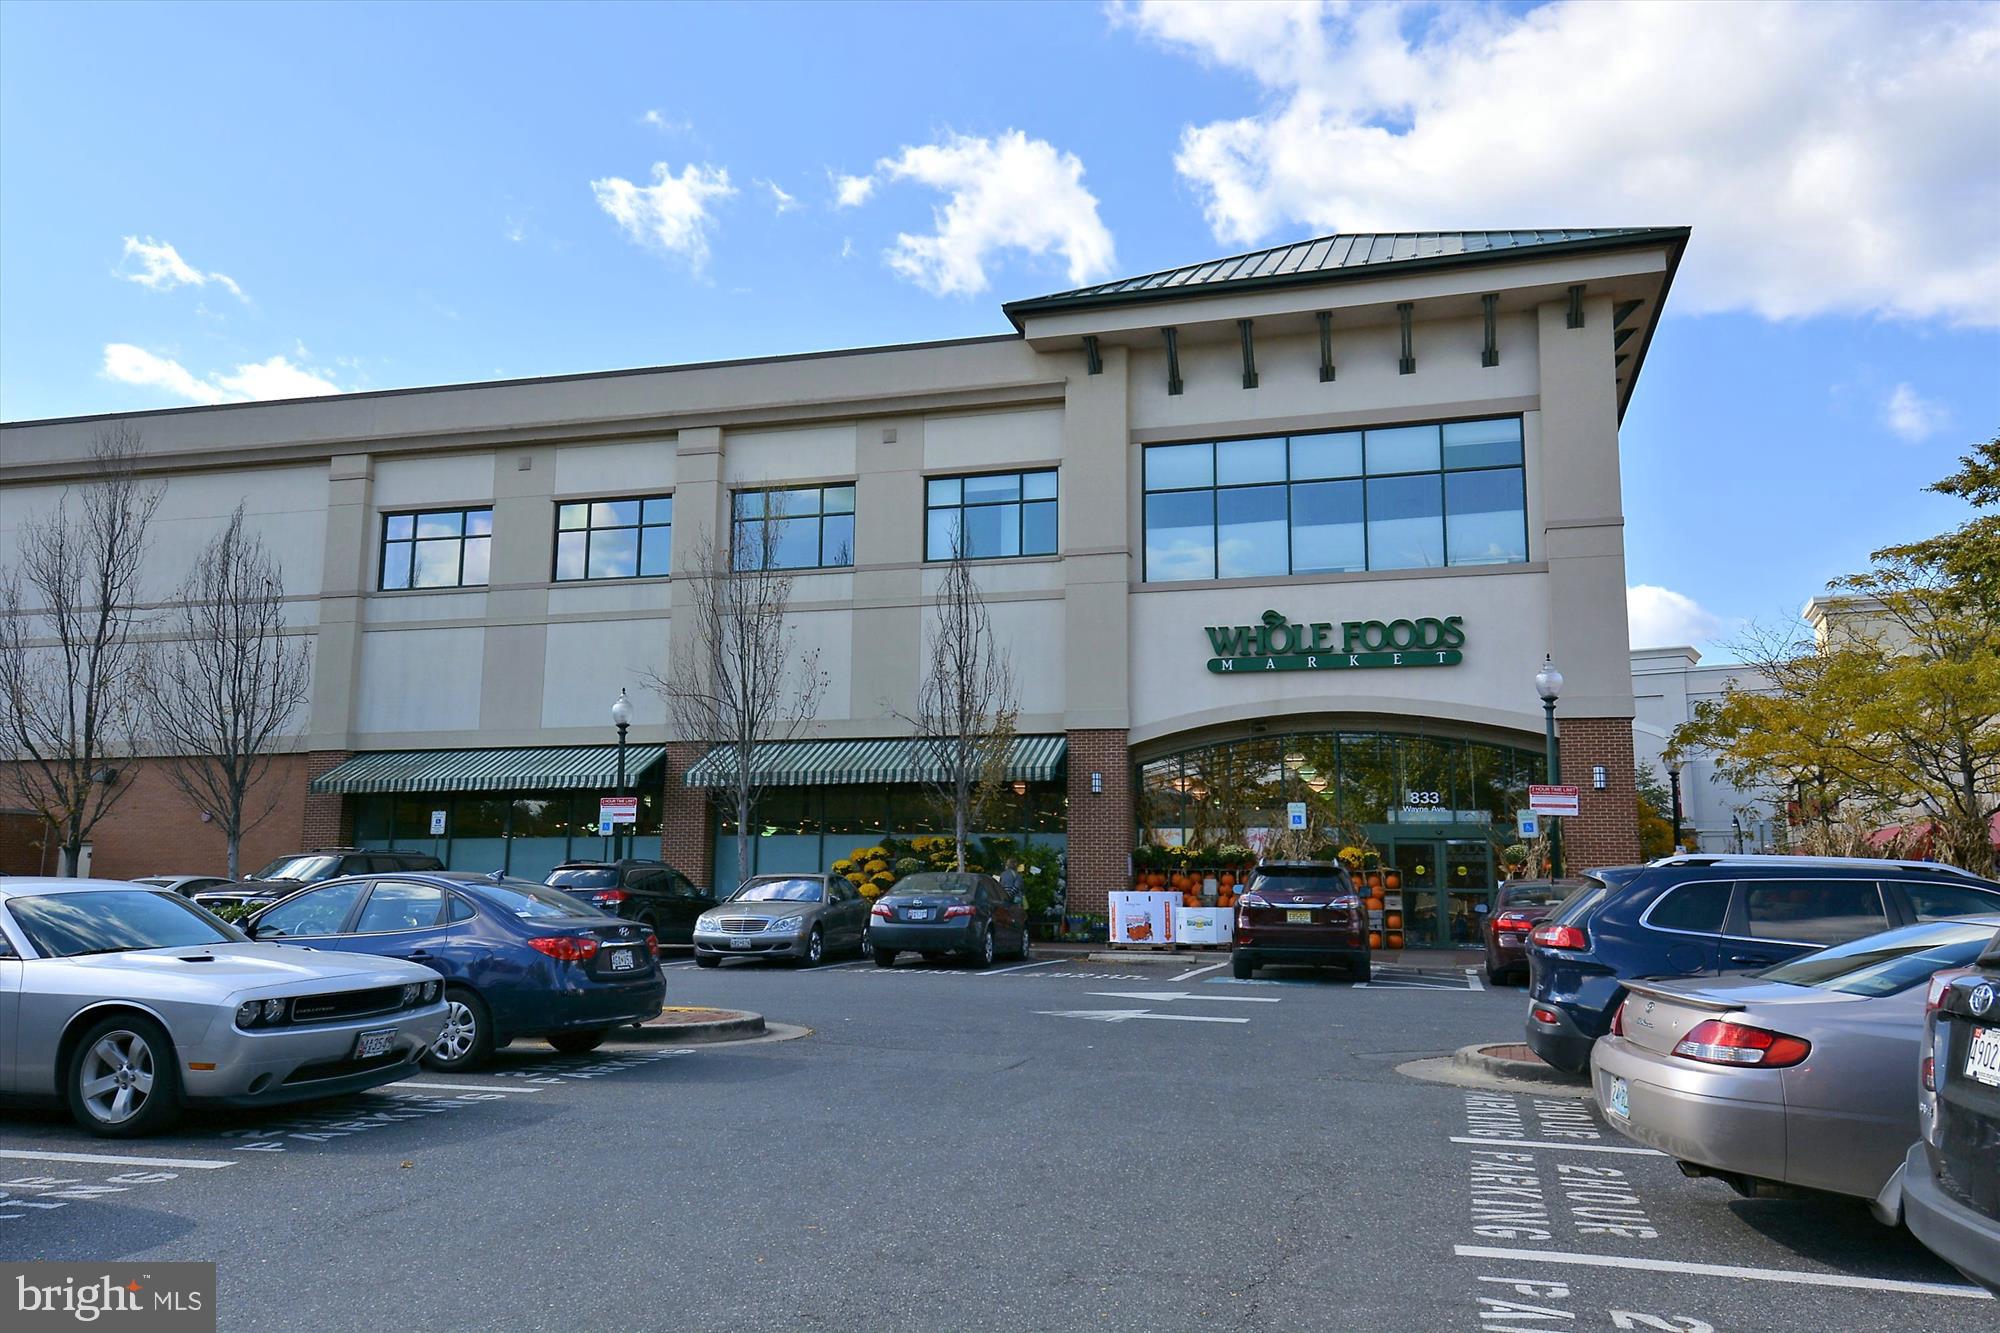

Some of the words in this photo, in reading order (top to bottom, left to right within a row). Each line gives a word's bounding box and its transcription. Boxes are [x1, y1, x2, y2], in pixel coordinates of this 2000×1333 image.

[1204, 620, 1333, 656] WHOLE
[1341, 616, 1466, 652] FOODS
[1221, 651, 1447, 671] MARKET
[1410, 791, 1440, 804] 833
[1402, 805, 1429, 813] Wayne
[1471, 1150, 1553, 1240] PARKING
